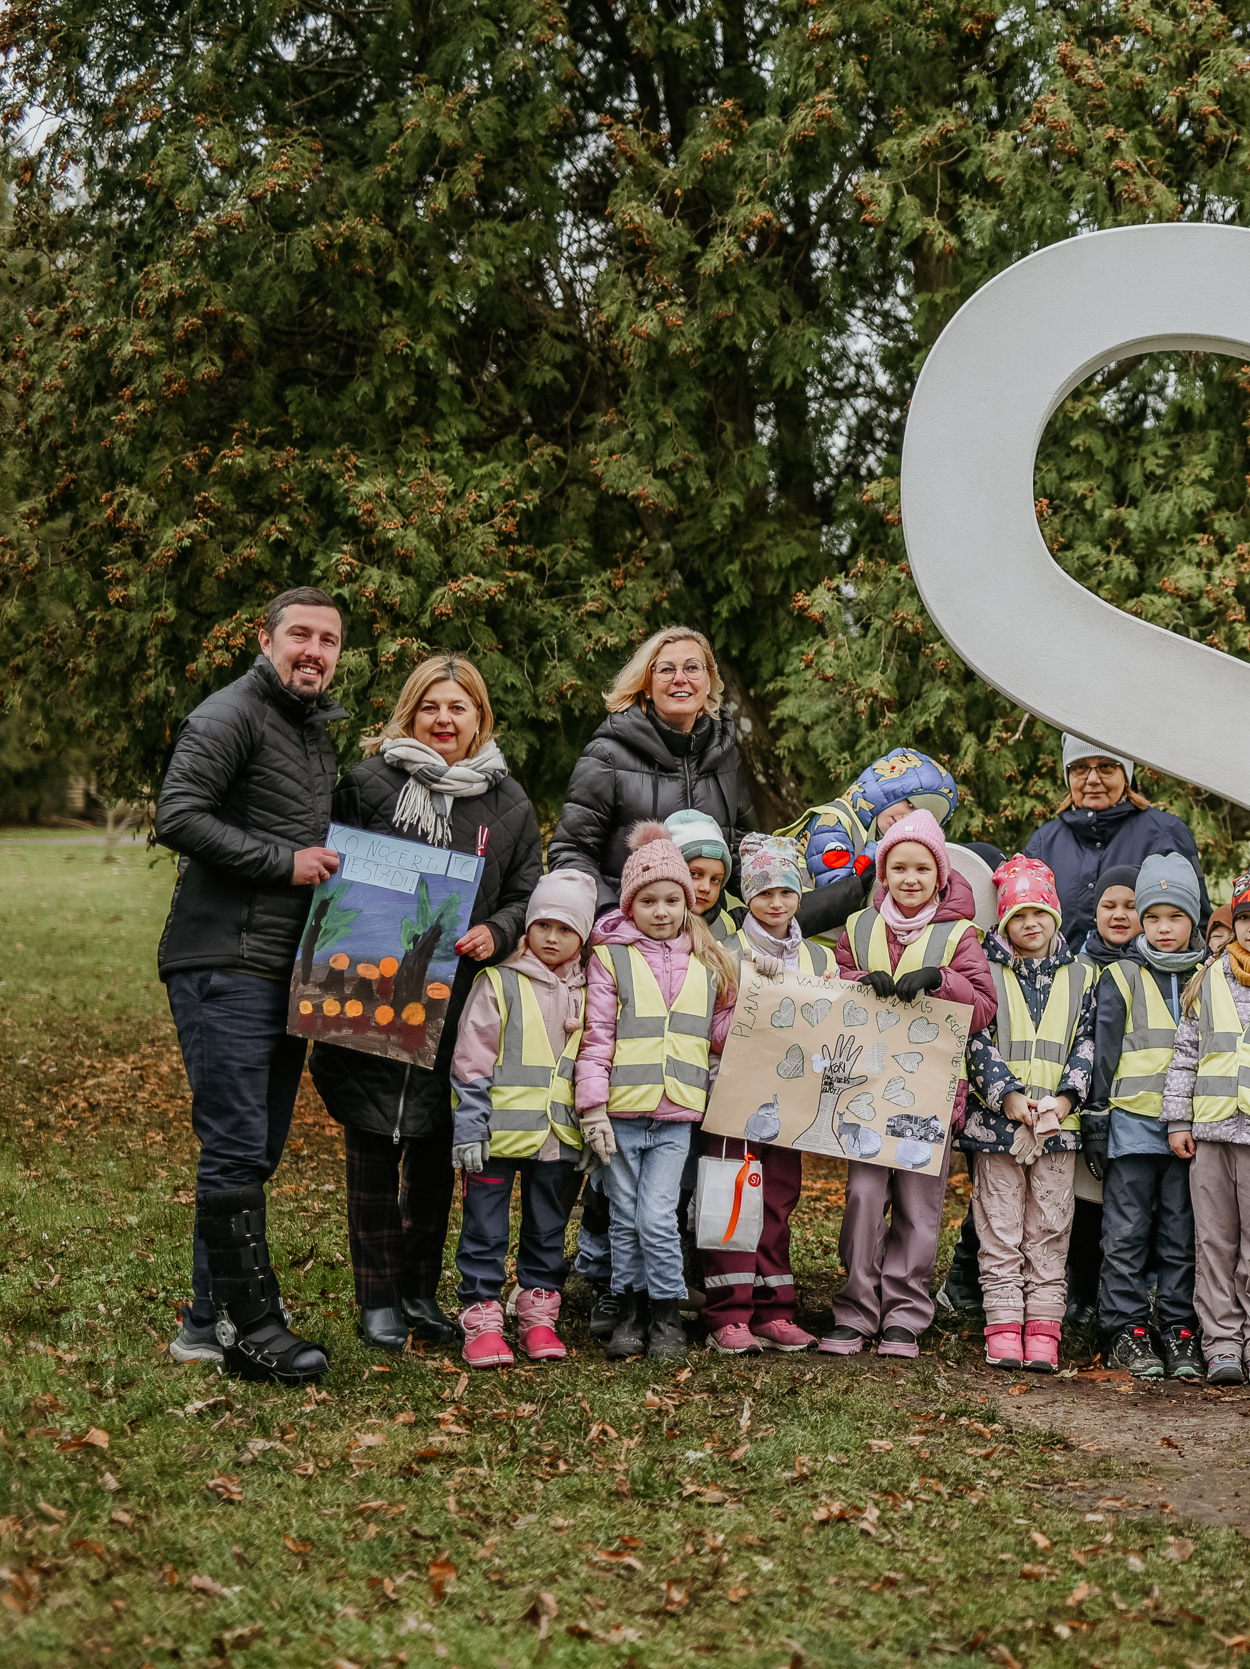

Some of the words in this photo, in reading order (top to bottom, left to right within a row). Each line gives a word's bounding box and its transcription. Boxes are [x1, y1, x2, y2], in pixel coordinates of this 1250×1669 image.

[328, 825, 359, 854] KO
[452, 856, 476, 877] TO
[828, 1061, 846, 1075] KOKI
[750, 1175, 760, 1185] S!
